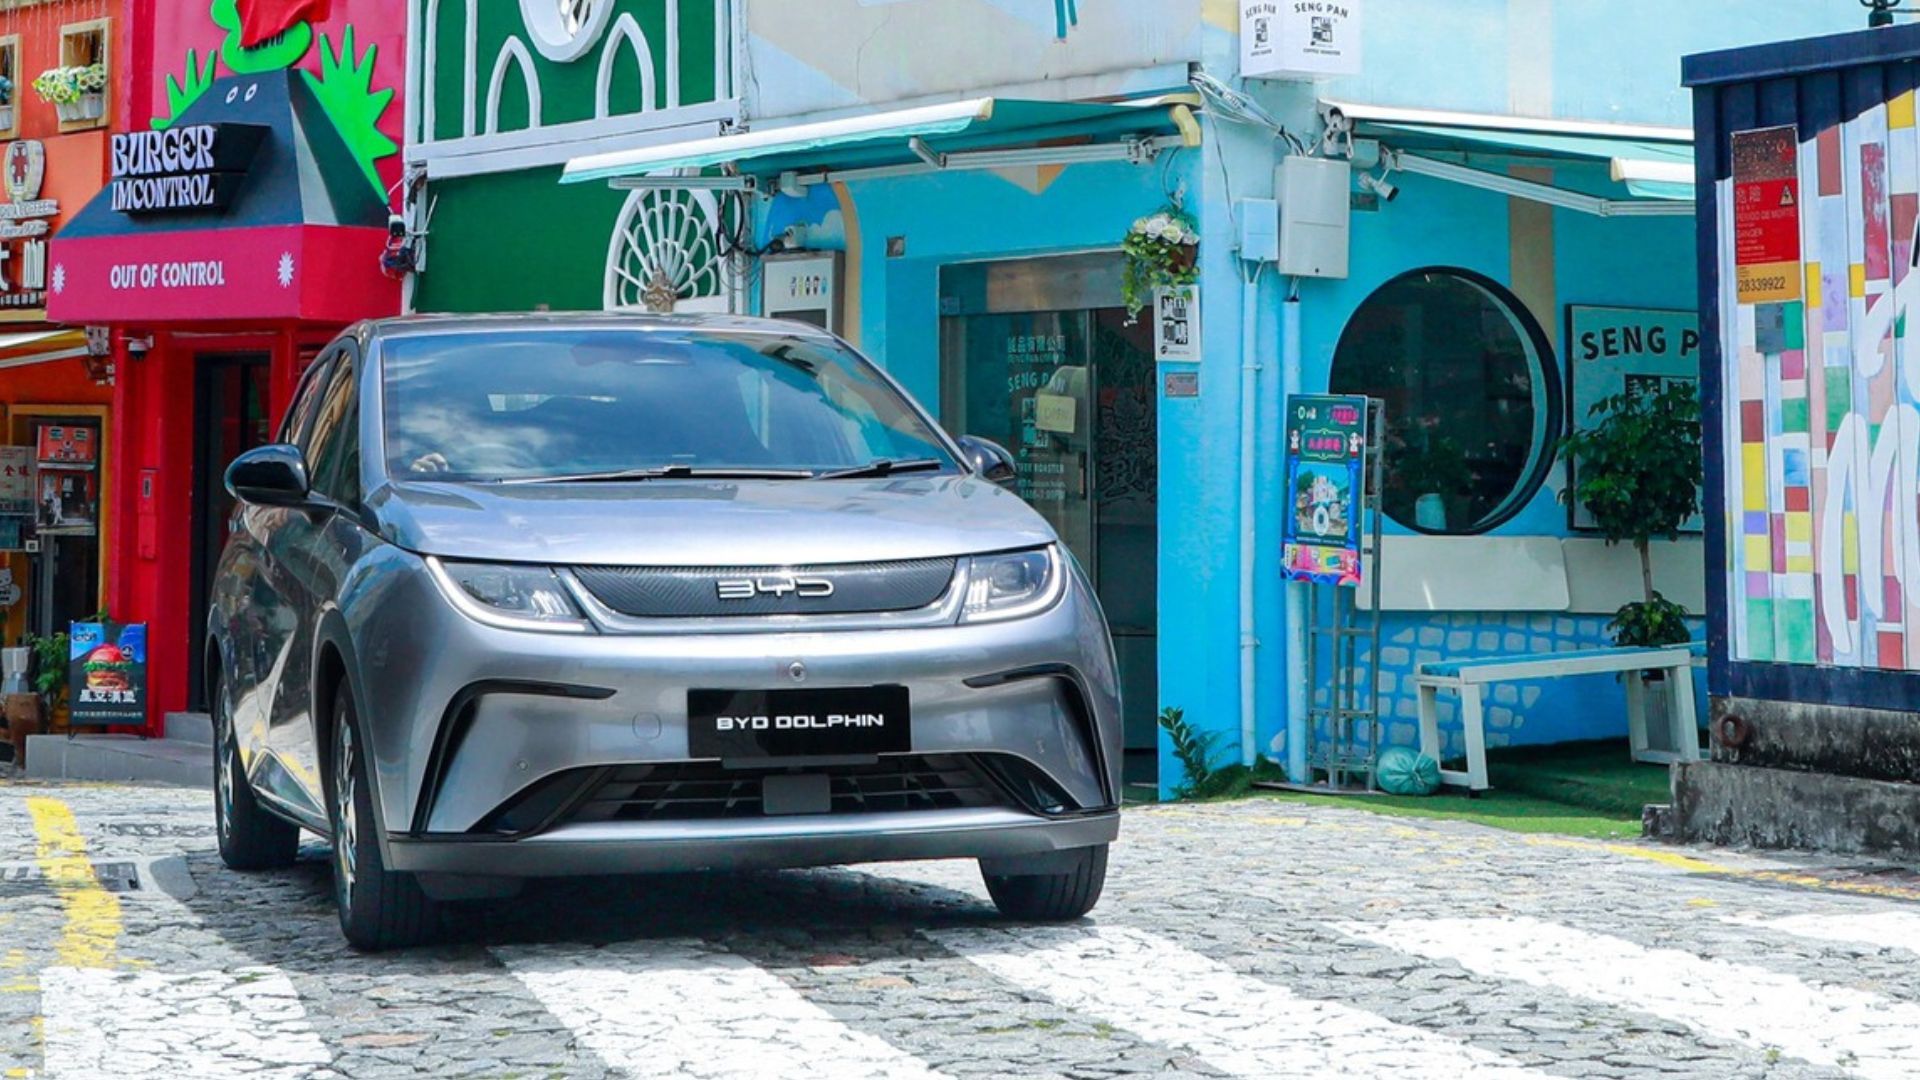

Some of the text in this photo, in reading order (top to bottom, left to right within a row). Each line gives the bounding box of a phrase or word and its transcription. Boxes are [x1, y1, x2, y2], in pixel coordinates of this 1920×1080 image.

[1294, 2, 1348, 18] SENG PAN
[111, 125, 216, 177] BURGER
[111, 174, 214, 211] IMCONTROL
[110, 260, 225, 289] OUT OF CONTROL
[1738, 276, 1786, 293] 28339922
[1580, 325, 1667, 361] SENG
[1008, 371, 1037, 393] SENG
[716, 577, 835, 599] BYD
[716, 714, 884, 731] BYD DOLPHIN
